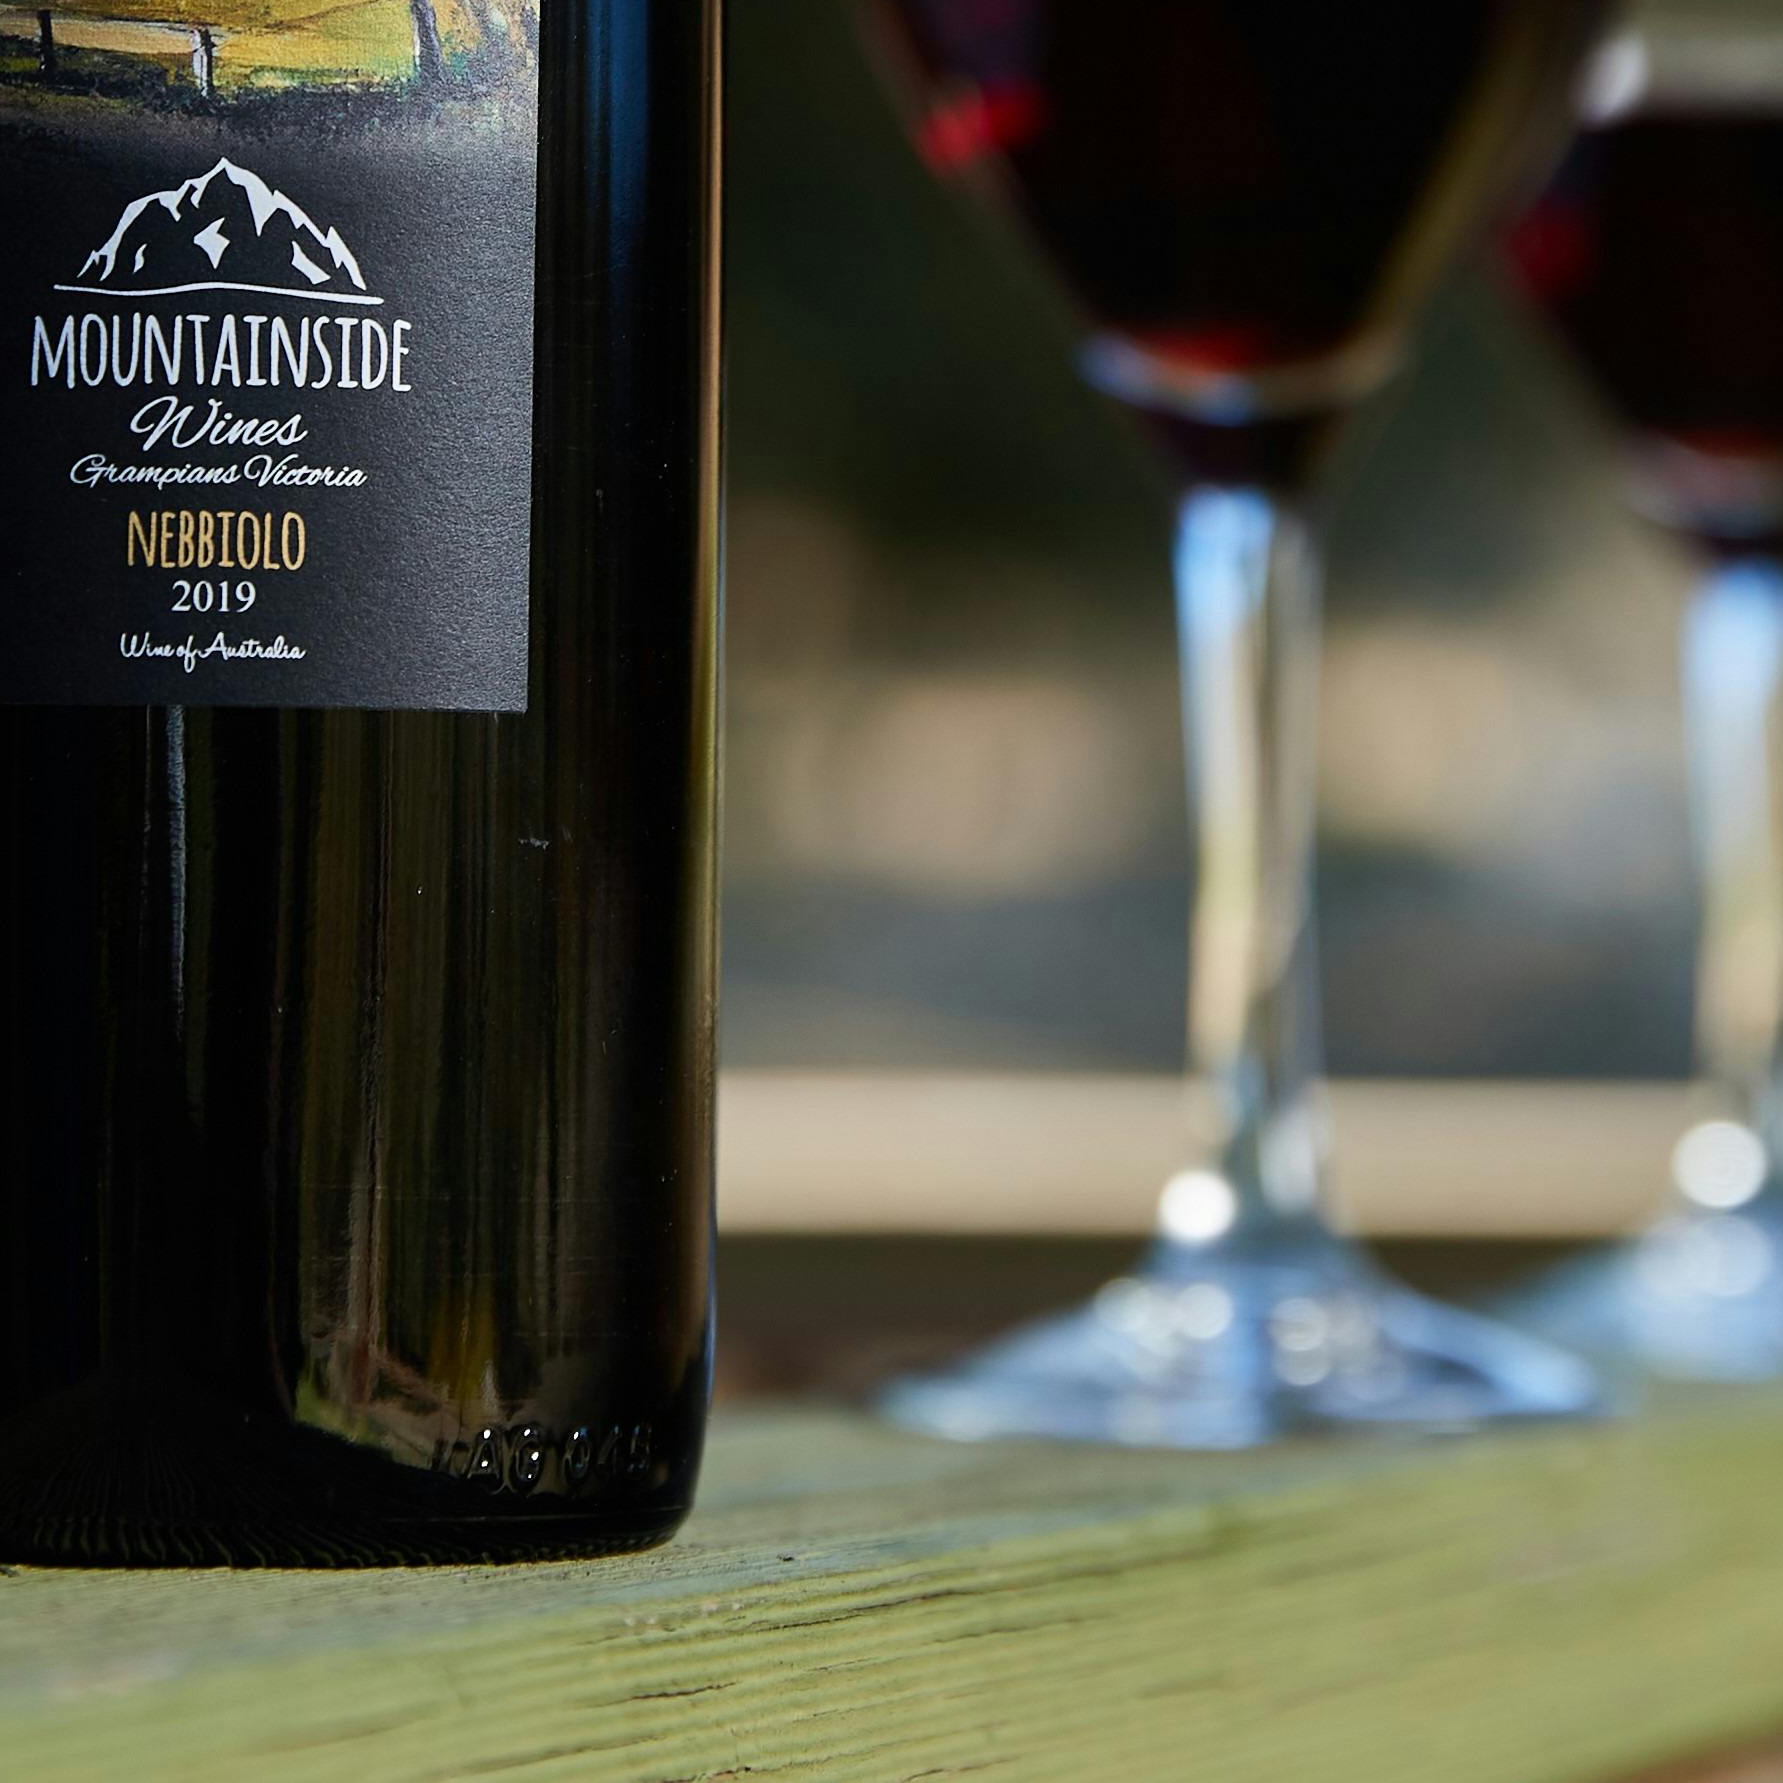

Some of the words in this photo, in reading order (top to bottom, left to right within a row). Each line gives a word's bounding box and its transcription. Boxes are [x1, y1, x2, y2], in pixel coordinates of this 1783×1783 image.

[30, 310, 414, 393] MOUNTAINSIDE
[128, 394, 310, 452] Wines
[68, 452, 242, 492] Grampians
[242, 453, 369, 490] Victoria
[126, 510, 308, 572] NEBBIOLO
[171, 579, 257, 614] 2019
[119, 631, 176, 659] Wine
[176, 635, 200, 674] of
[198, 631, 307, 662] Australia
